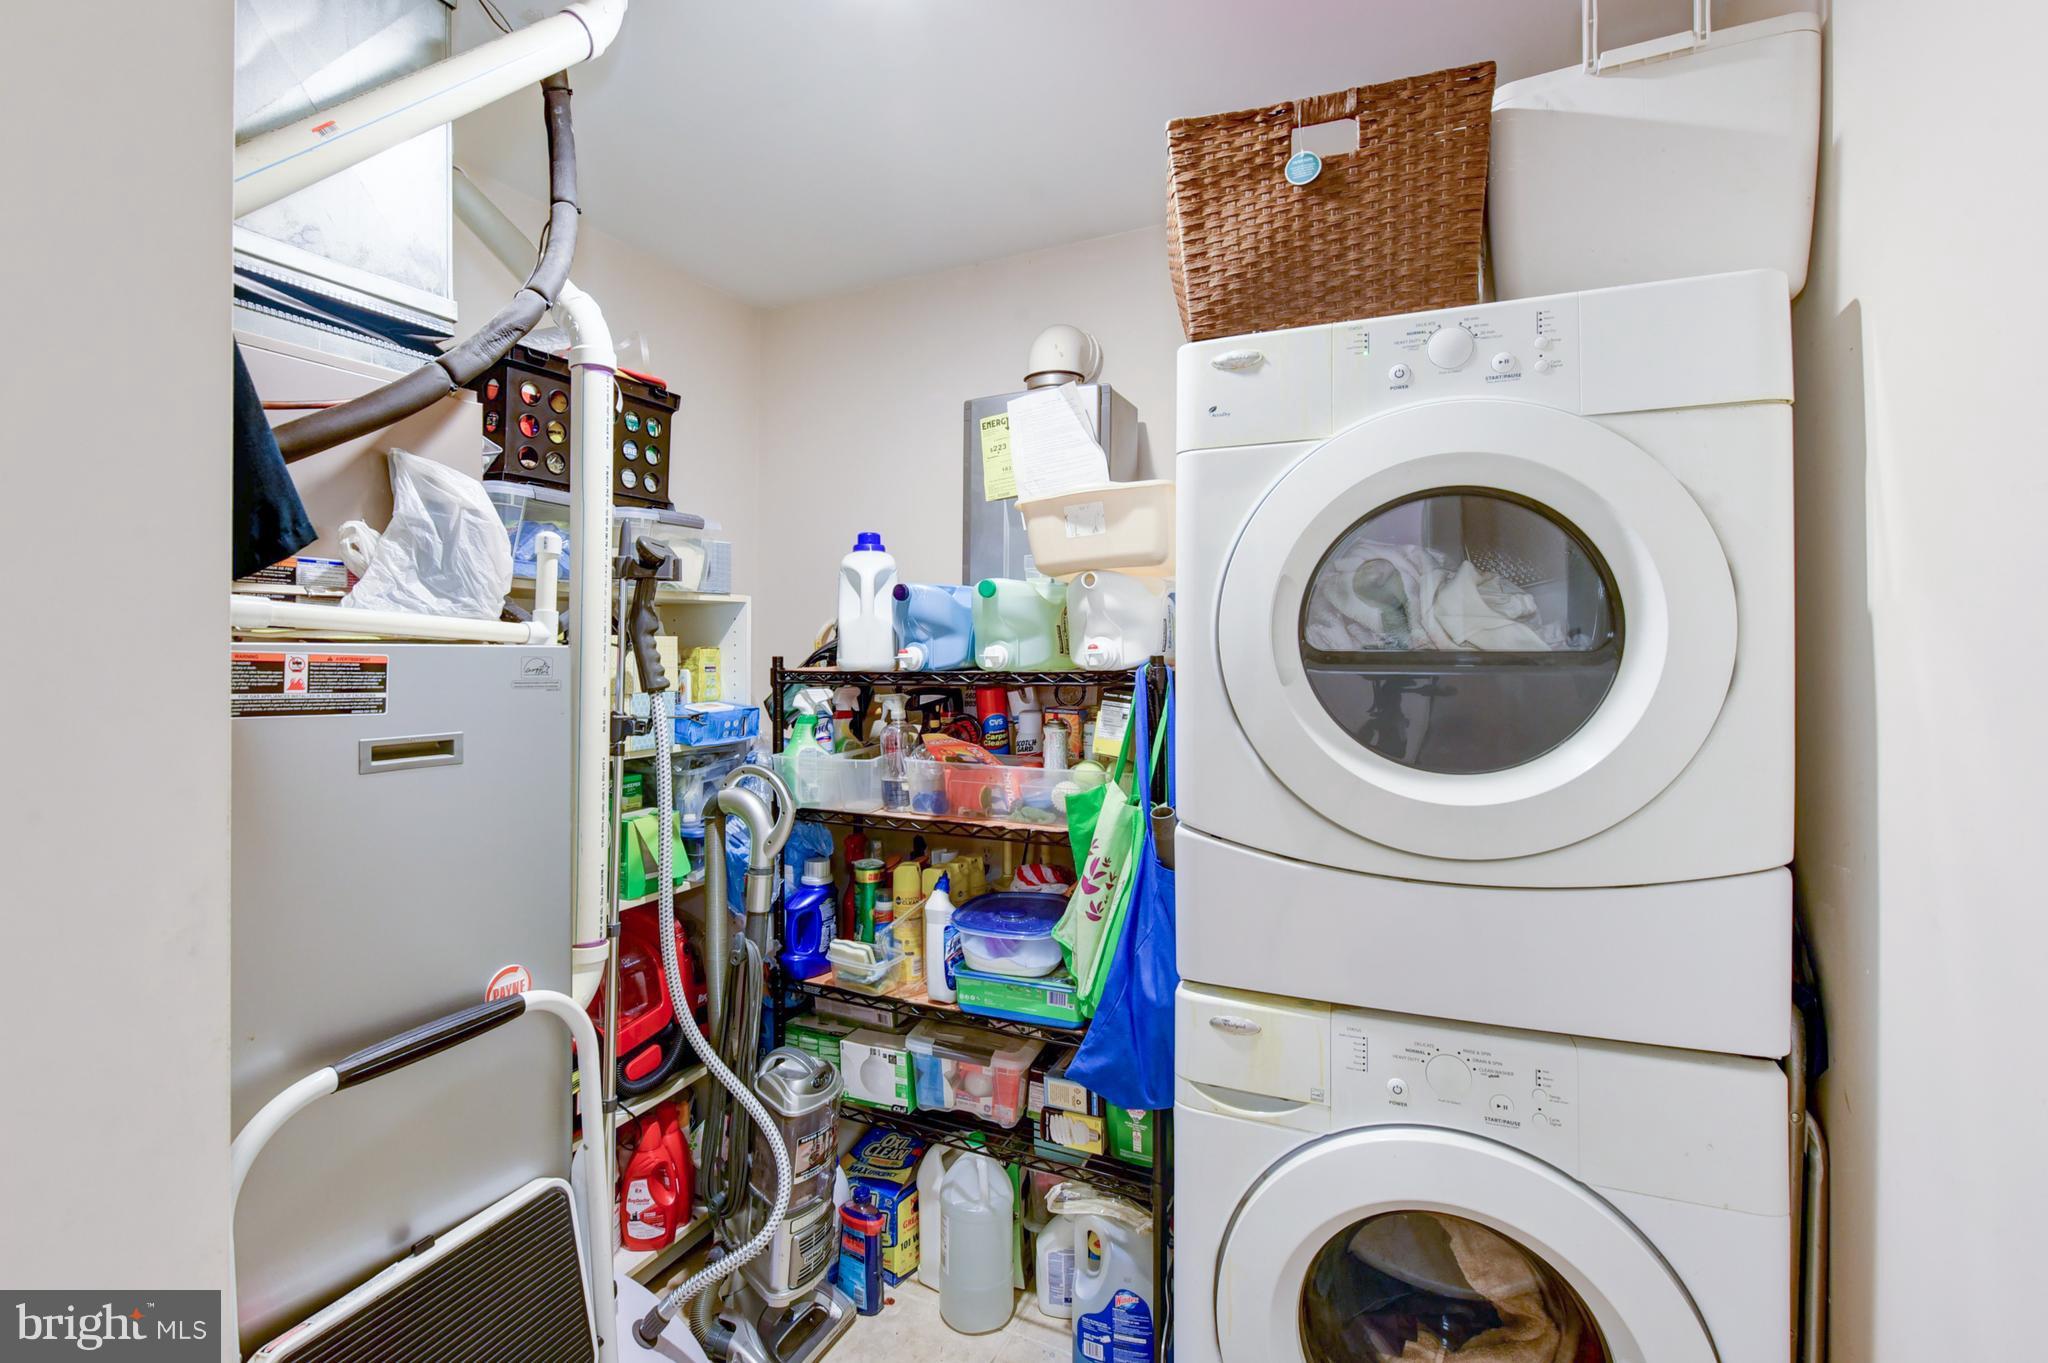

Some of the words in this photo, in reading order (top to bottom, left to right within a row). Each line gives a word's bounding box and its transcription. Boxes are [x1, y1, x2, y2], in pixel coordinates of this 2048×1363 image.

[988, 719, 1004, 727] CVS
[492, 978, 525, 1002] PAYNE
[1388, 1099, 1408, 1108] POWER
[881, 1134, 910, 1150] OXI
[864, 1144, 910, 1161] CLEAN
